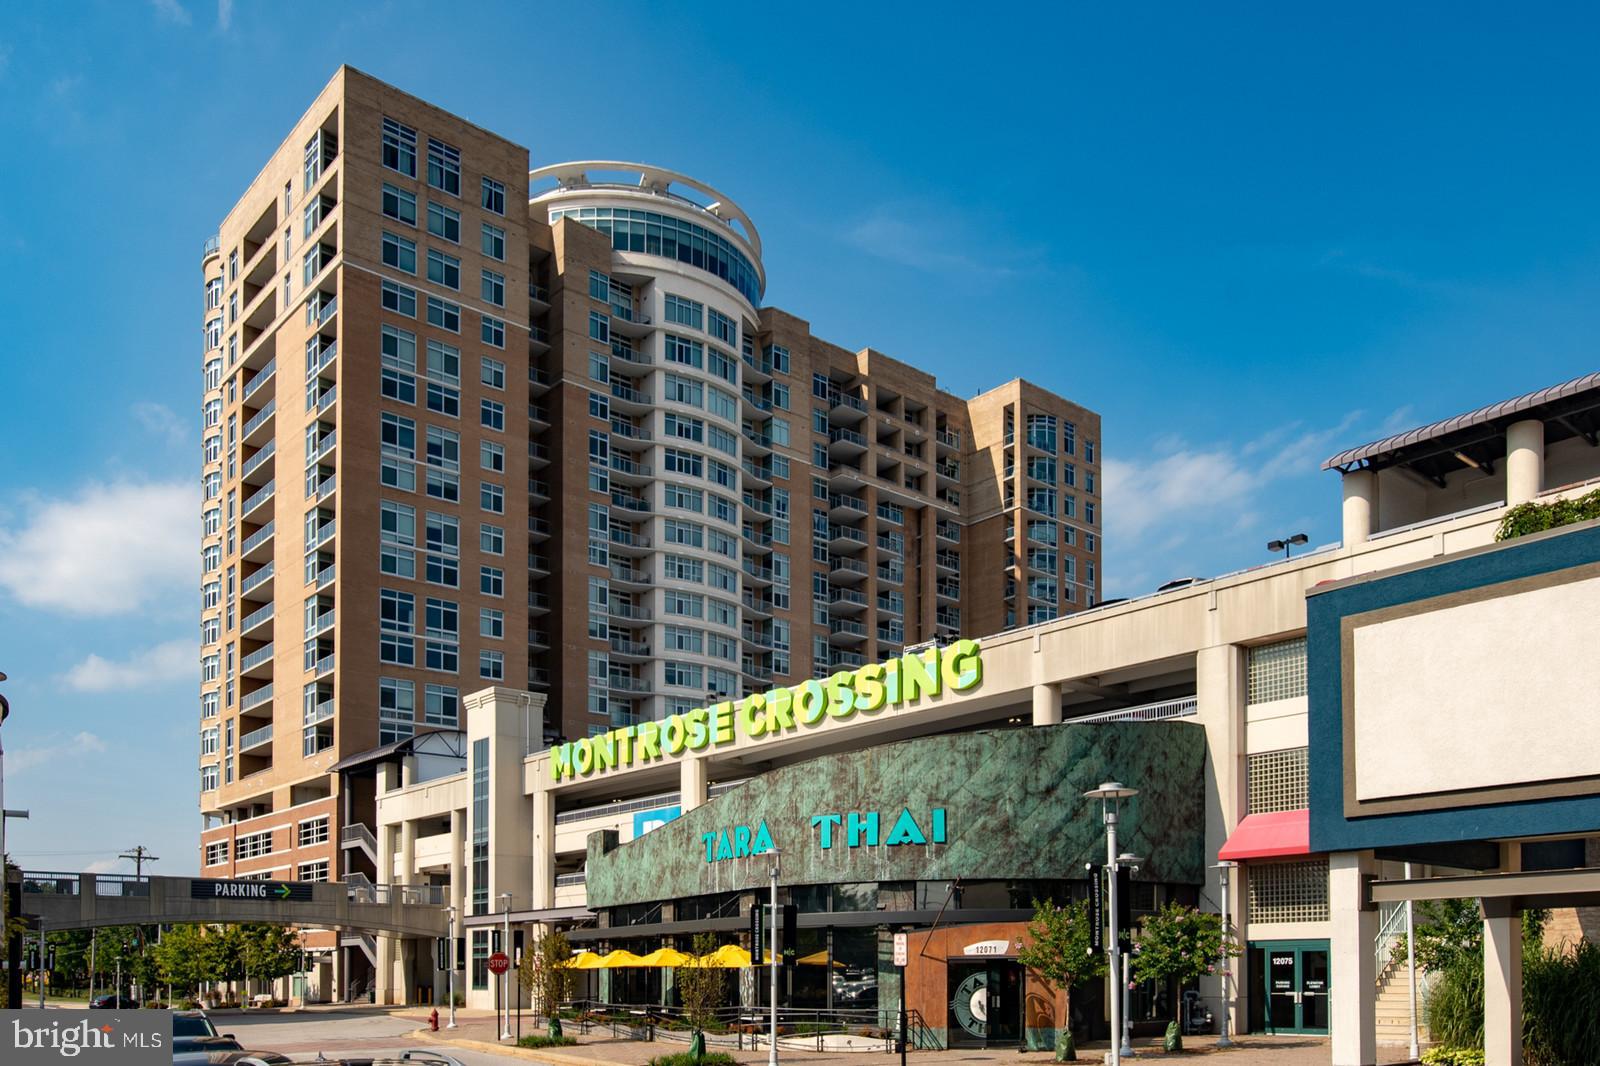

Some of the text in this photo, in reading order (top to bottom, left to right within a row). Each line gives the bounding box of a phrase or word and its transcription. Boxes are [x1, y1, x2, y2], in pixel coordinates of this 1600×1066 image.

[550, 639, 983, 781] MONTROSE CROSSING
[702, 807, 947, 863] TARA THAI
[215, 883, 267, 897] PARKING
[975, 946, 997, 954] 12071
[490, 959, 508, 968] STOP
[1272, 957, 1293, 965] 12075
